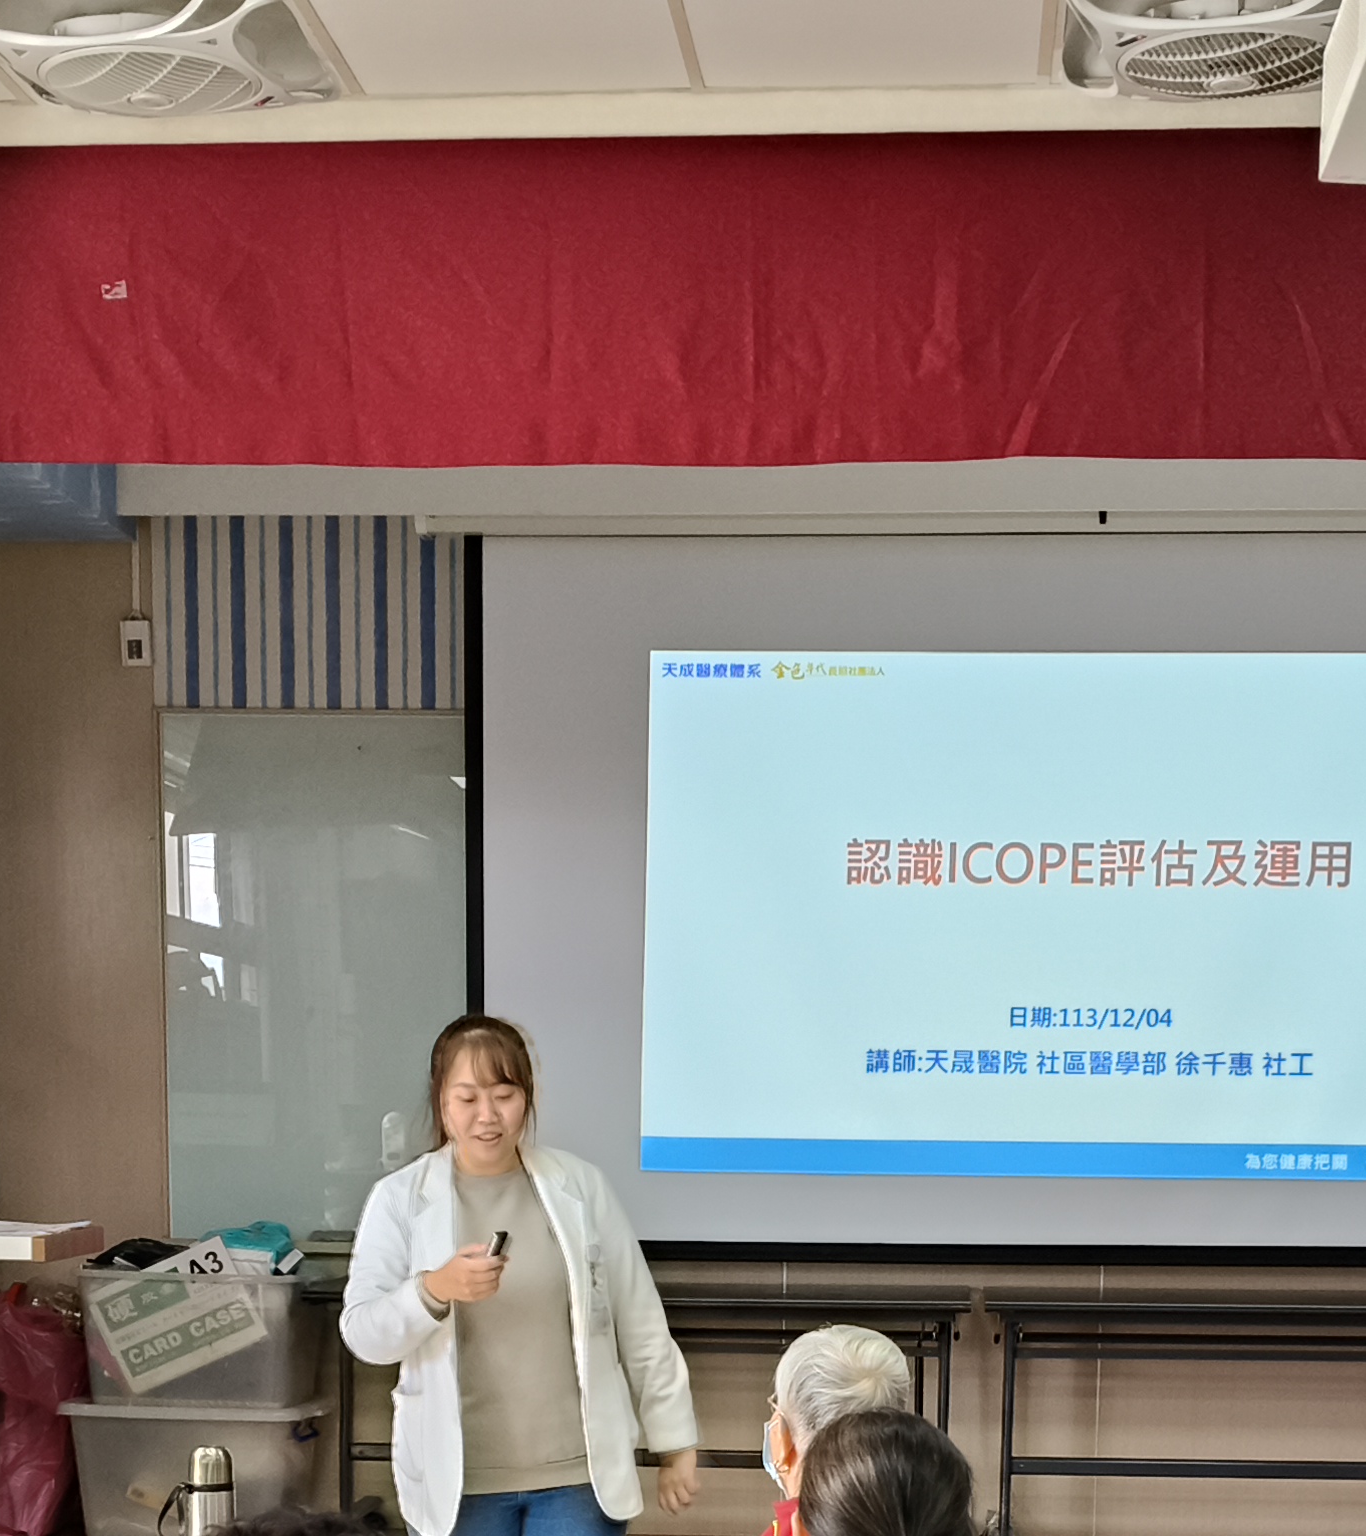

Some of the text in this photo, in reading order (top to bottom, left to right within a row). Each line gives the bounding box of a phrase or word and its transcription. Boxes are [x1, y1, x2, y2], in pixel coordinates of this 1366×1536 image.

[661, 662, 762, 679] 天成醫療體系
[846, 837, 1353, 888] 認識ICOPE評估及運用
[1009, 1006, 1174, 1030] 日期:113/12/04
[865, 1048, 1315, 1077] 講師:天晟醫院 社區醫學部 徐千惠 社工
[128, 1303, 247, 1365] CARD CASE
